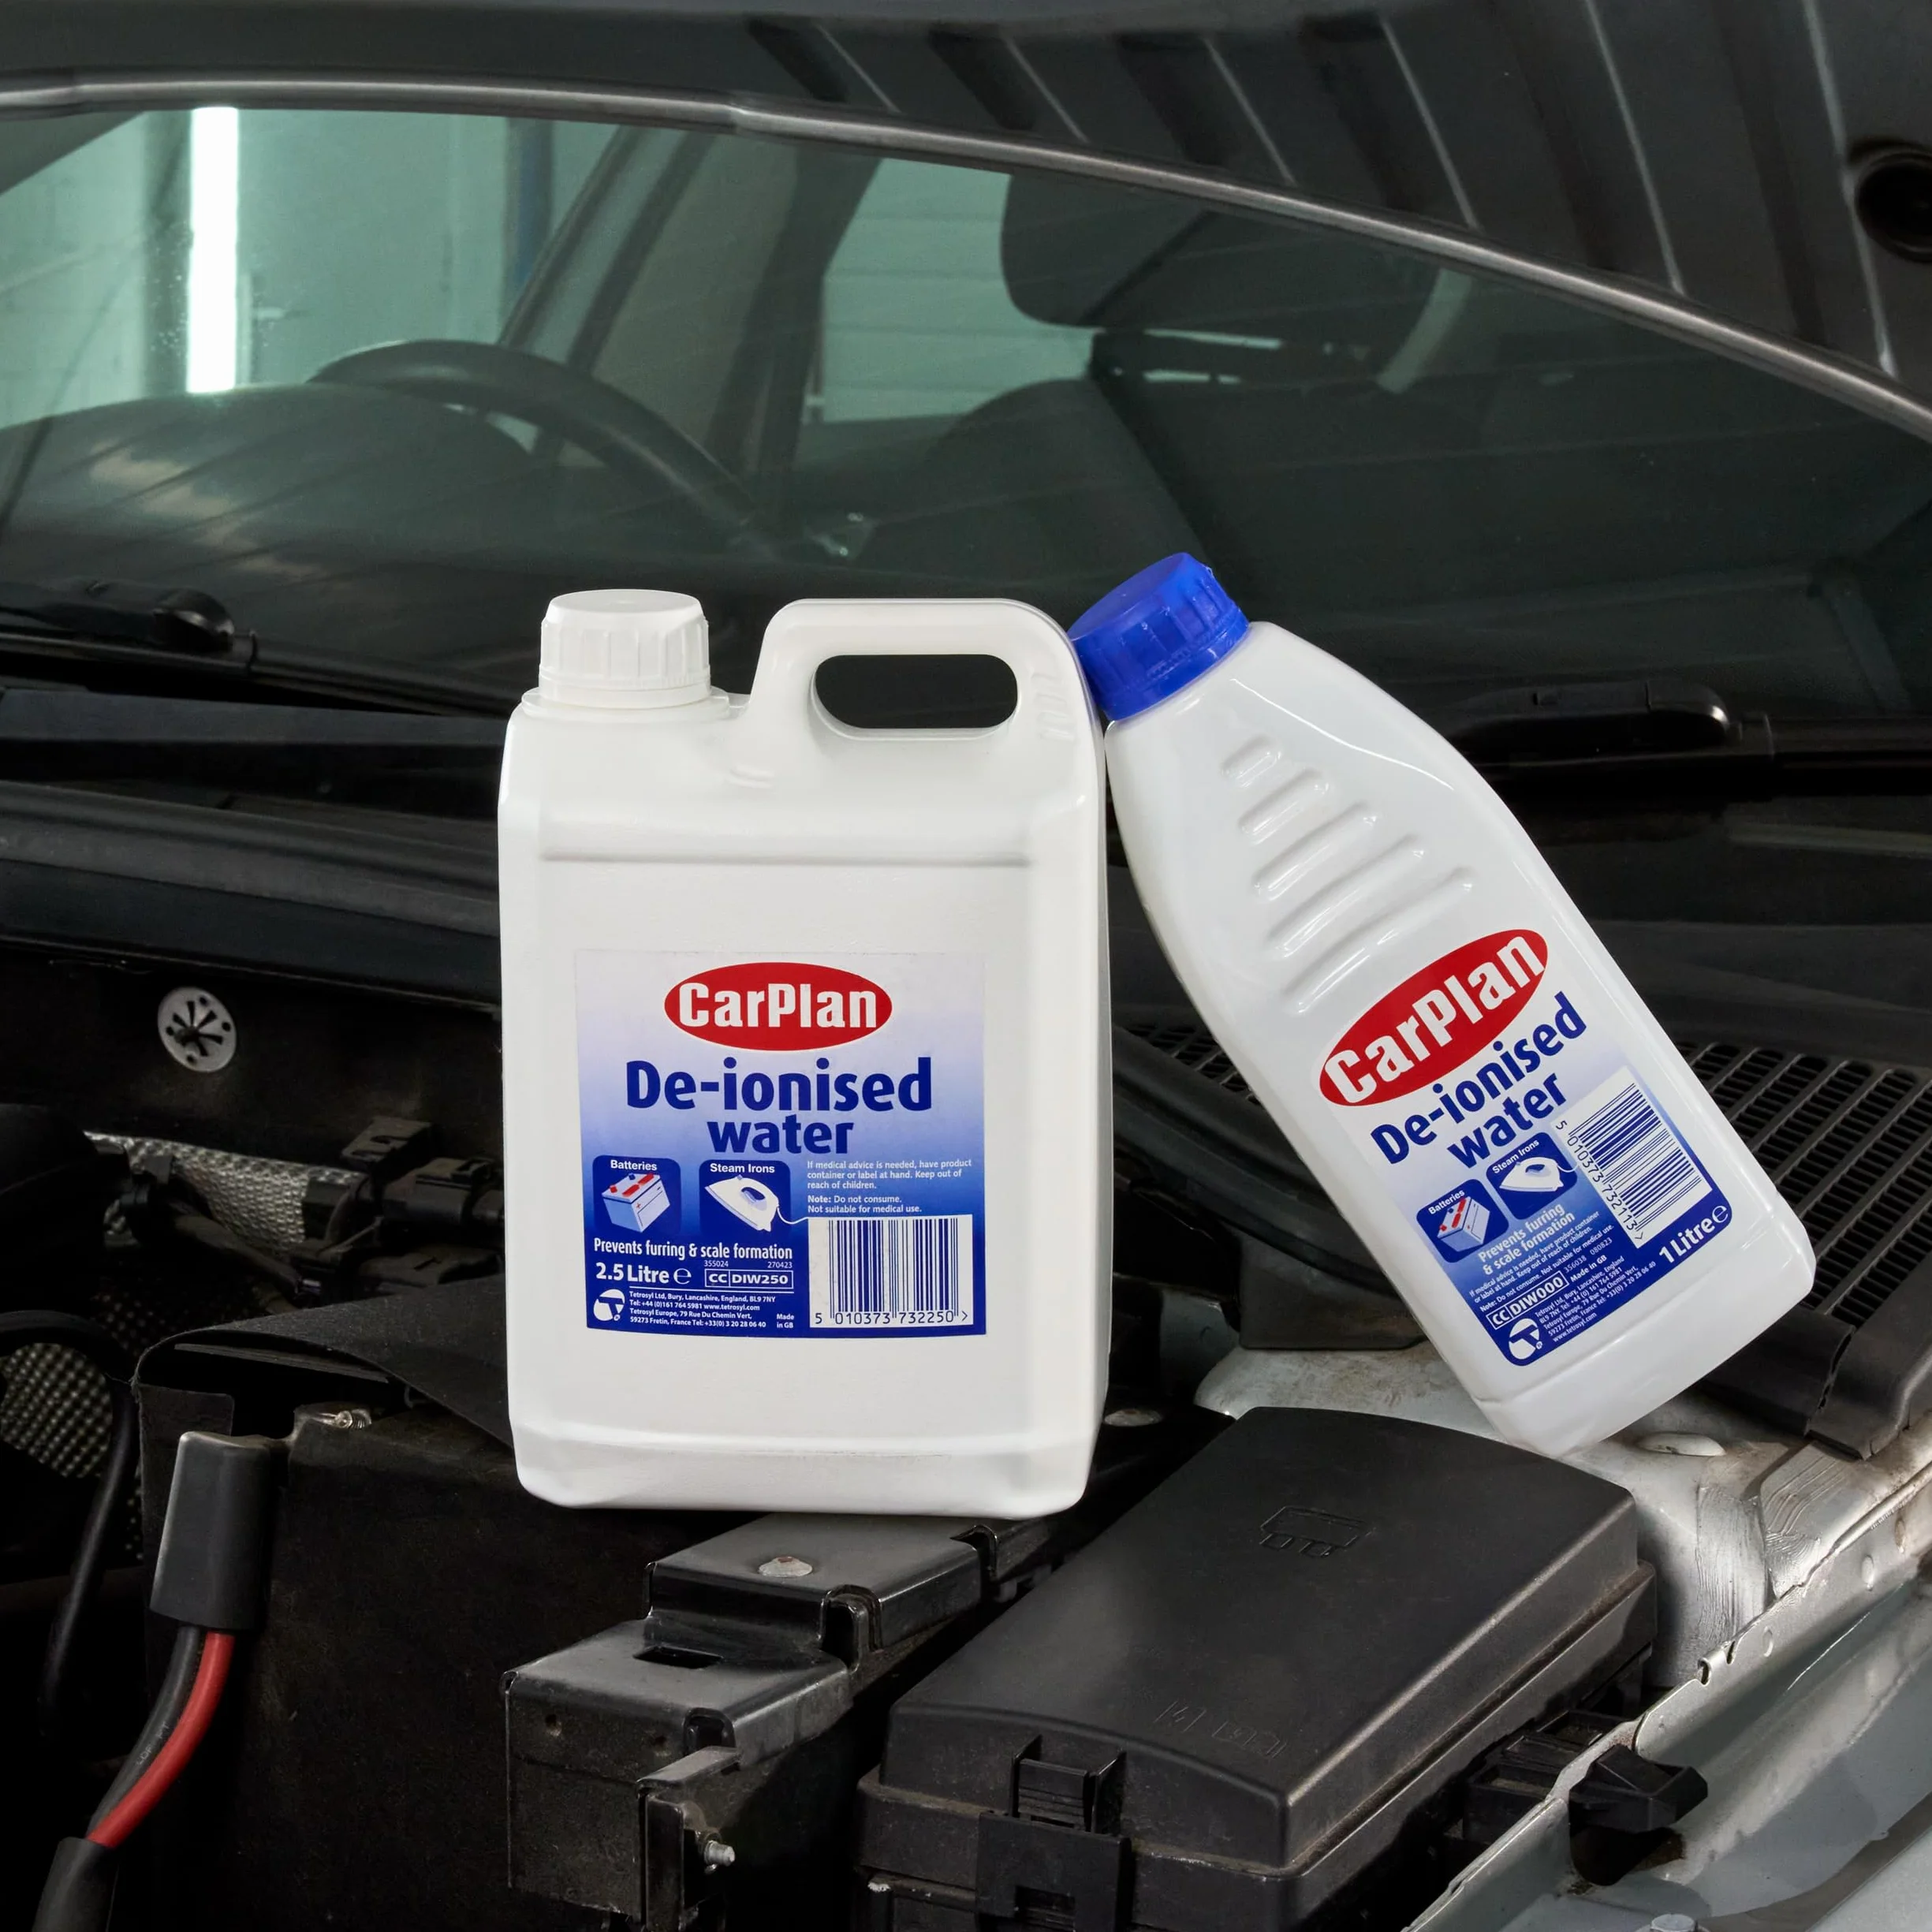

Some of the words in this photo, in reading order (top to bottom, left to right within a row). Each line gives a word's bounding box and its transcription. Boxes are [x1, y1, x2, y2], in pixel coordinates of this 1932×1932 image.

[679, 983, 876, 1028] CarPlan
[1324, 934, 1545, 1104] CarPlan
[626, 1057, 931, 1111] De-ionised
[1371, 991, 1587, 1165] De-ionised
[707, 1114, 854, 1154] water
[1447, 1070, 1568, 1169] water
[611, 1160, 657, 1170] Batteries
[711, 1164, 744, 1173] Steam
[748, 1164, 774, 1173] Irons
[916, 1170, 934, 1179] Keep
[1492, 1154, 1519, 1173] Steam
[1518, 1140, 1539, 1156] Irons
[1428, 1190, 1465, 1214] Batteries
[1567, 1136, 1604, 1183] 010373
[1602, 1184, 1639, 1231] 732113
[595, 1238, 642, 1255] Prevents
[646, 1240, 685, 1260] furring
[689, 1244, 696, 1258] &
[701, 1243, 729, 1258] scale
[734, 1244, 793, 1259] formation
[1475, 1278, 1496, 1294] medical
[1518, 1251, 1541, 1268] needed,
[1553, 1228, 1578, 1248] product
[1575, 1211, 1599, 1231] container
[1478, 1229, 1526, 1263] Prevents
[1525, 1204, 1565, 1233] furring
[1494, 1248, 1522, 1269] scale
[1520, 1213, 1575, 1251] formation
[1569, 1226, 1592, 1244] children.
[1670, 1218, 1715, 1256] Litre
[596, 1263, 624, 1280] 2.5
[628, 1264, 669, 1283] Litre
[709, 1274, 727, 1283] CC
[733, 1274, 788, 1284] DIW250
[1516, 1274, 1542, 1291] consume.
[1552, 1252, 1573, 1268] suitable
[1582, 1230, 1603, 1248] medical
[629, 1292, 654, 1300] Tetrosyl
[1509, 1277, 1564, 1315] DIW000
[1535, 1302, 1555, 1318] Tetrosyl
[1604, 1255, 1624, 1273] England
[1543, 1315, 1564, 1330] Tetrosyl
[1606, 1274, 1626, 1289] Chemin
[630, 1308, 654, 1317] Tetrosyl
[815, 1313, 822, 1324] 5
[835, 1313, 890, 1324] 010373
[899, 1311, 953, 1323] 732250
[1553, 1312, 1597, 1342] www.tetrosyl.com
